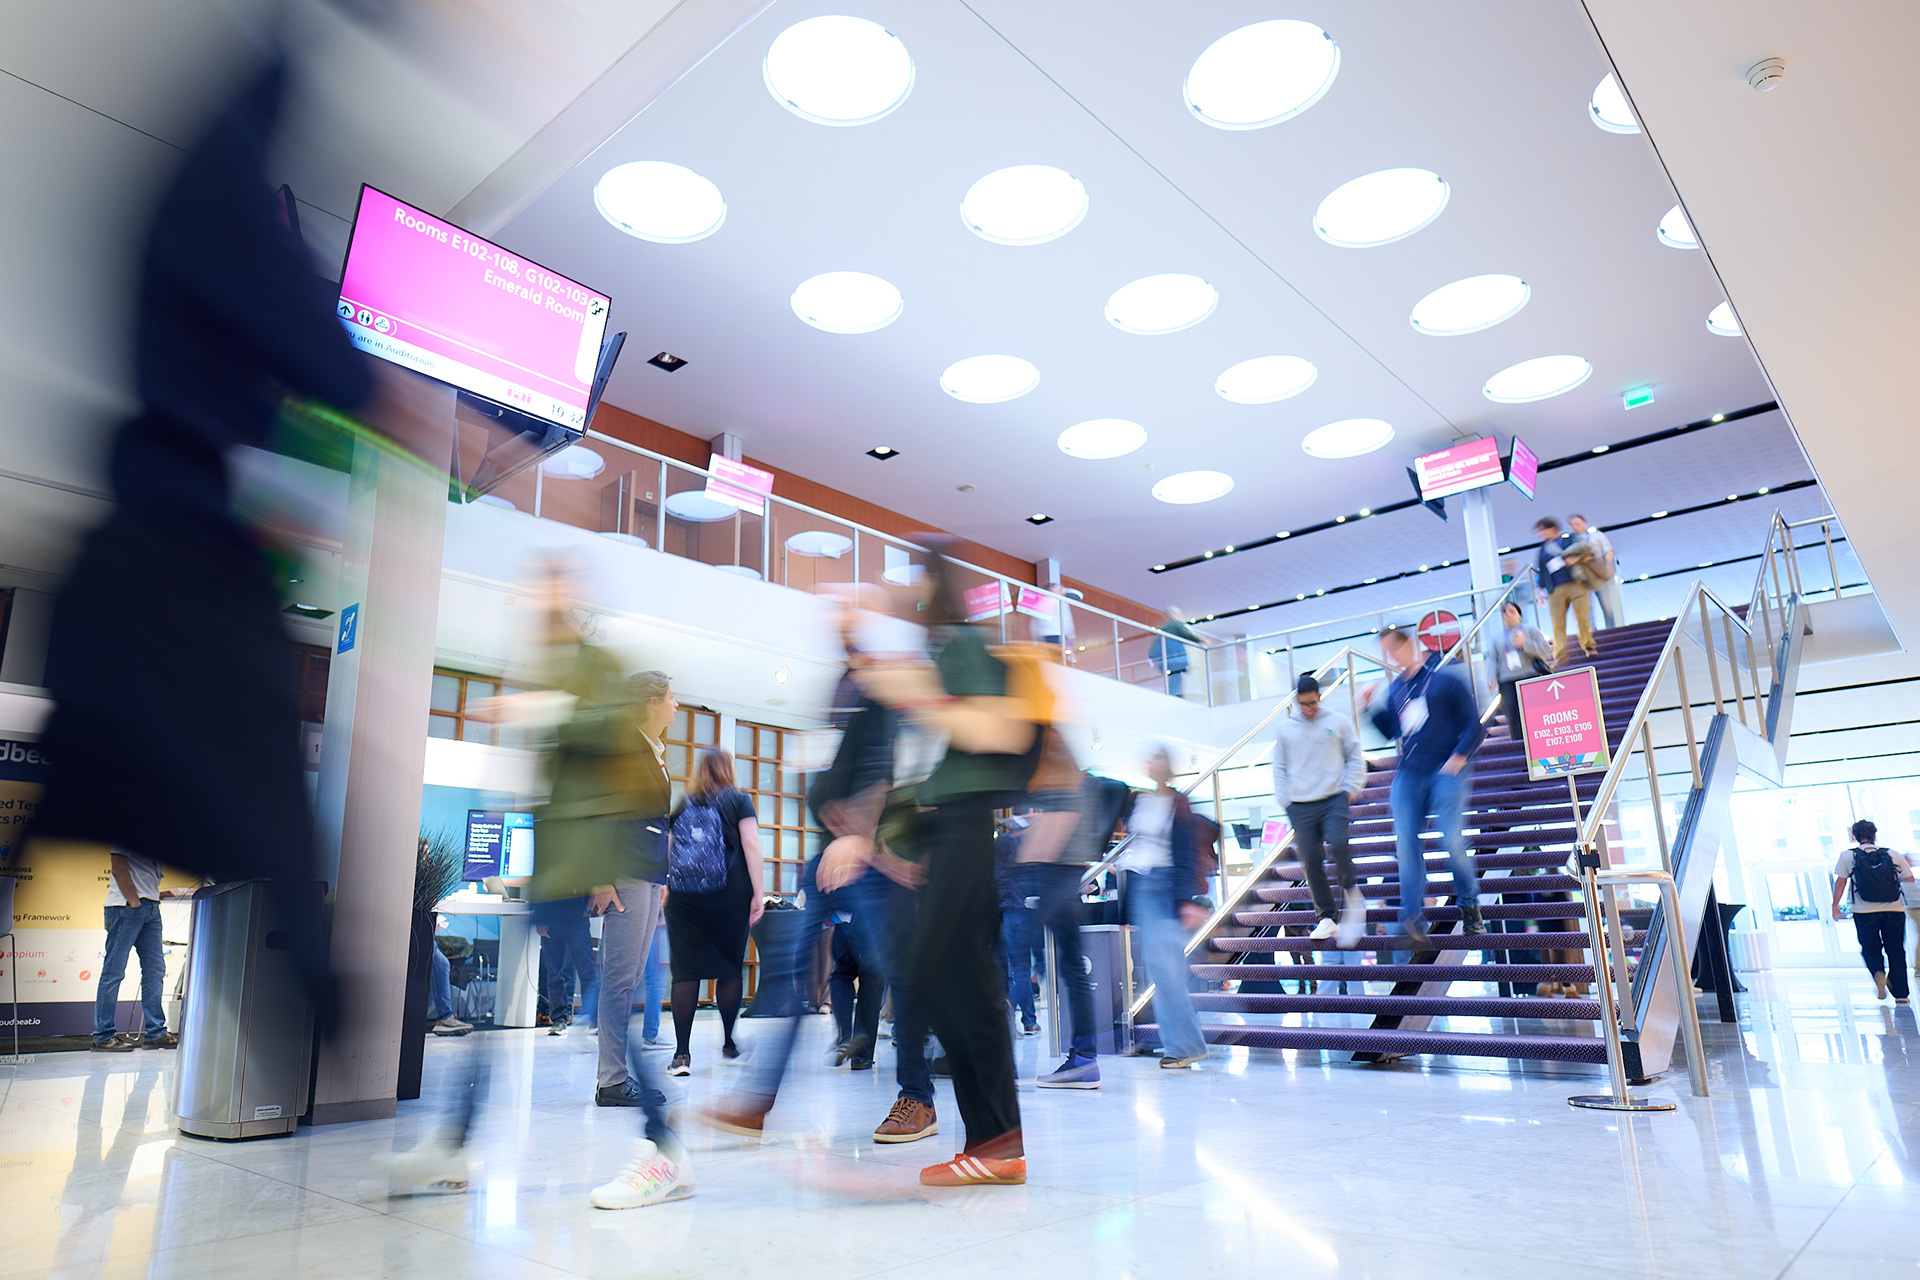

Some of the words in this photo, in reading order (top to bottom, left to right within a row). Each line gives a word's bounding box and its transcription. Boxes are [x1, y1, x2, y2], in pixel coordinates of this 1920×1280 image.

[394, 207, 448, 243] Rooms
[451, 234, 521, 278] E102-108,
[525, 268, 589, 306] G102-103
[484, 269, 542, 307] Emerald
[545, 295, 584, 323] Room
[345, 329, 355, 339] ou
[357, 334, 373, 345] are
[374, 338, 384, 349] in
[385, 344, 436, 368] Auditorium
[1542, 709, 1579, 726] ROOMS
[1574, 721, 1593, 732] E105
[1565, 733, 1583, 743] E108
[22, 913, 71, 921] Framework
